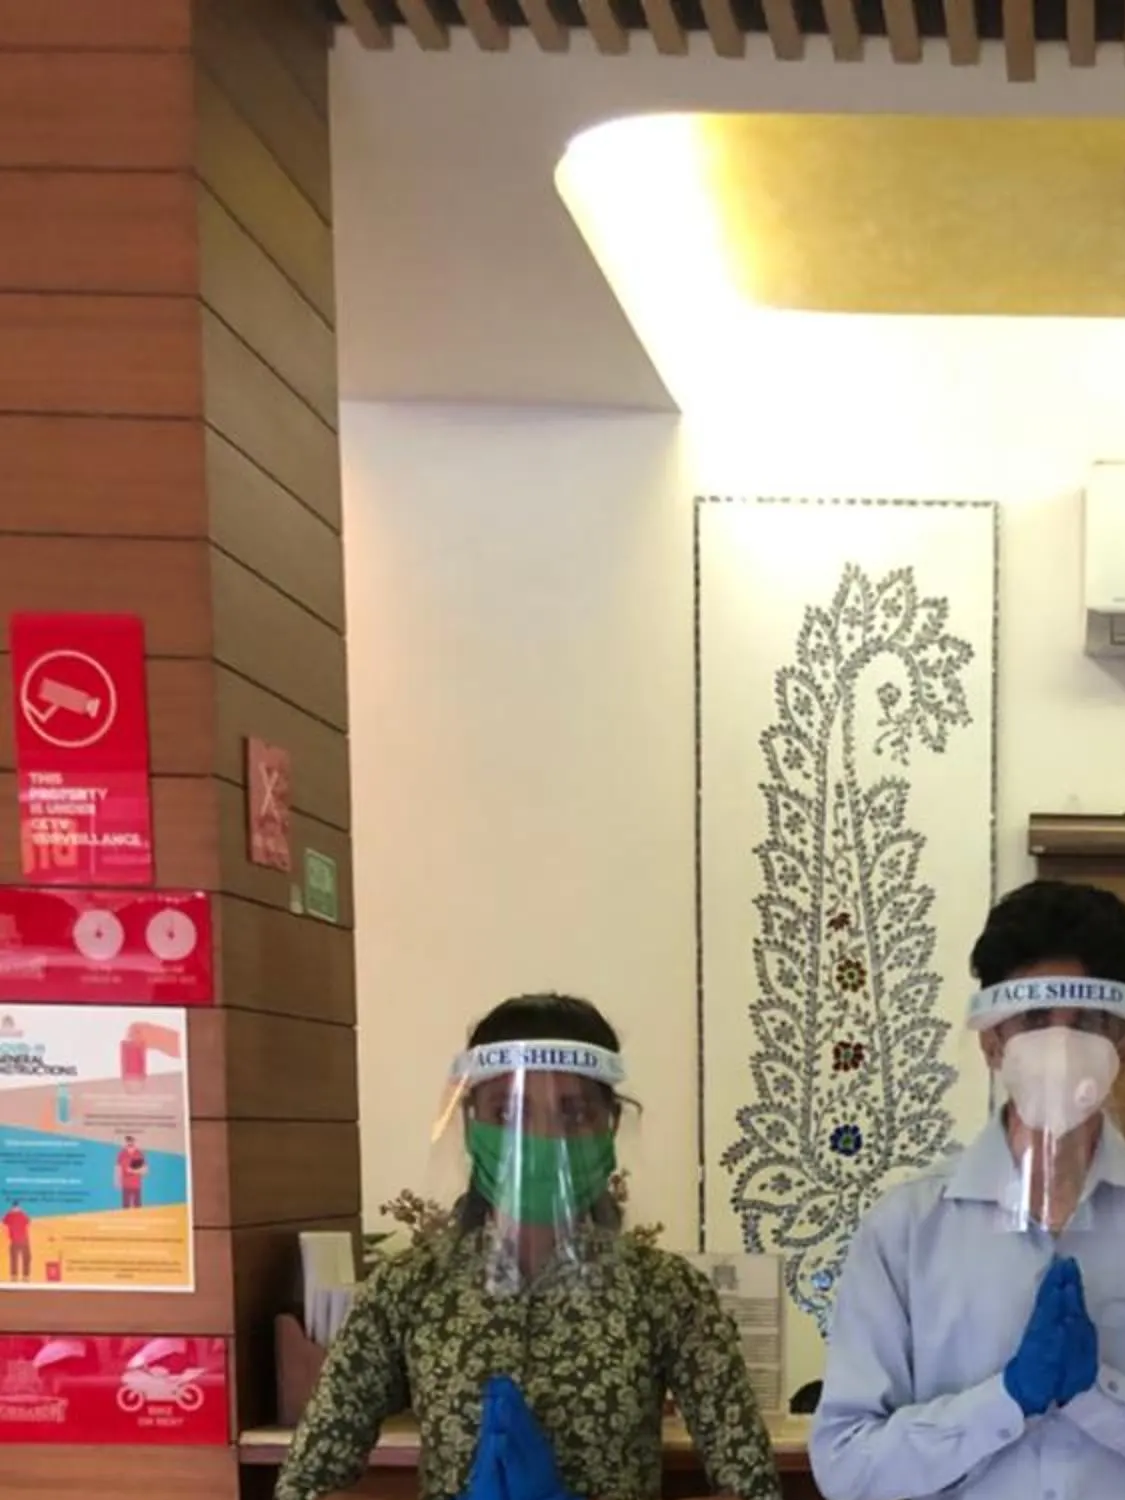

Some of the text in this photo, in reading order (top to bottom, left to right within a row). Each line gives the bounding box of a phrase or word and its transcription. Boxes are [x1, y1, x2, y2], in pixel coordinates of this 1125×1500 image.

[991, 983, 1124, 1004] FACE SHIELD
[475, 1049, 512, 1067] ACE
